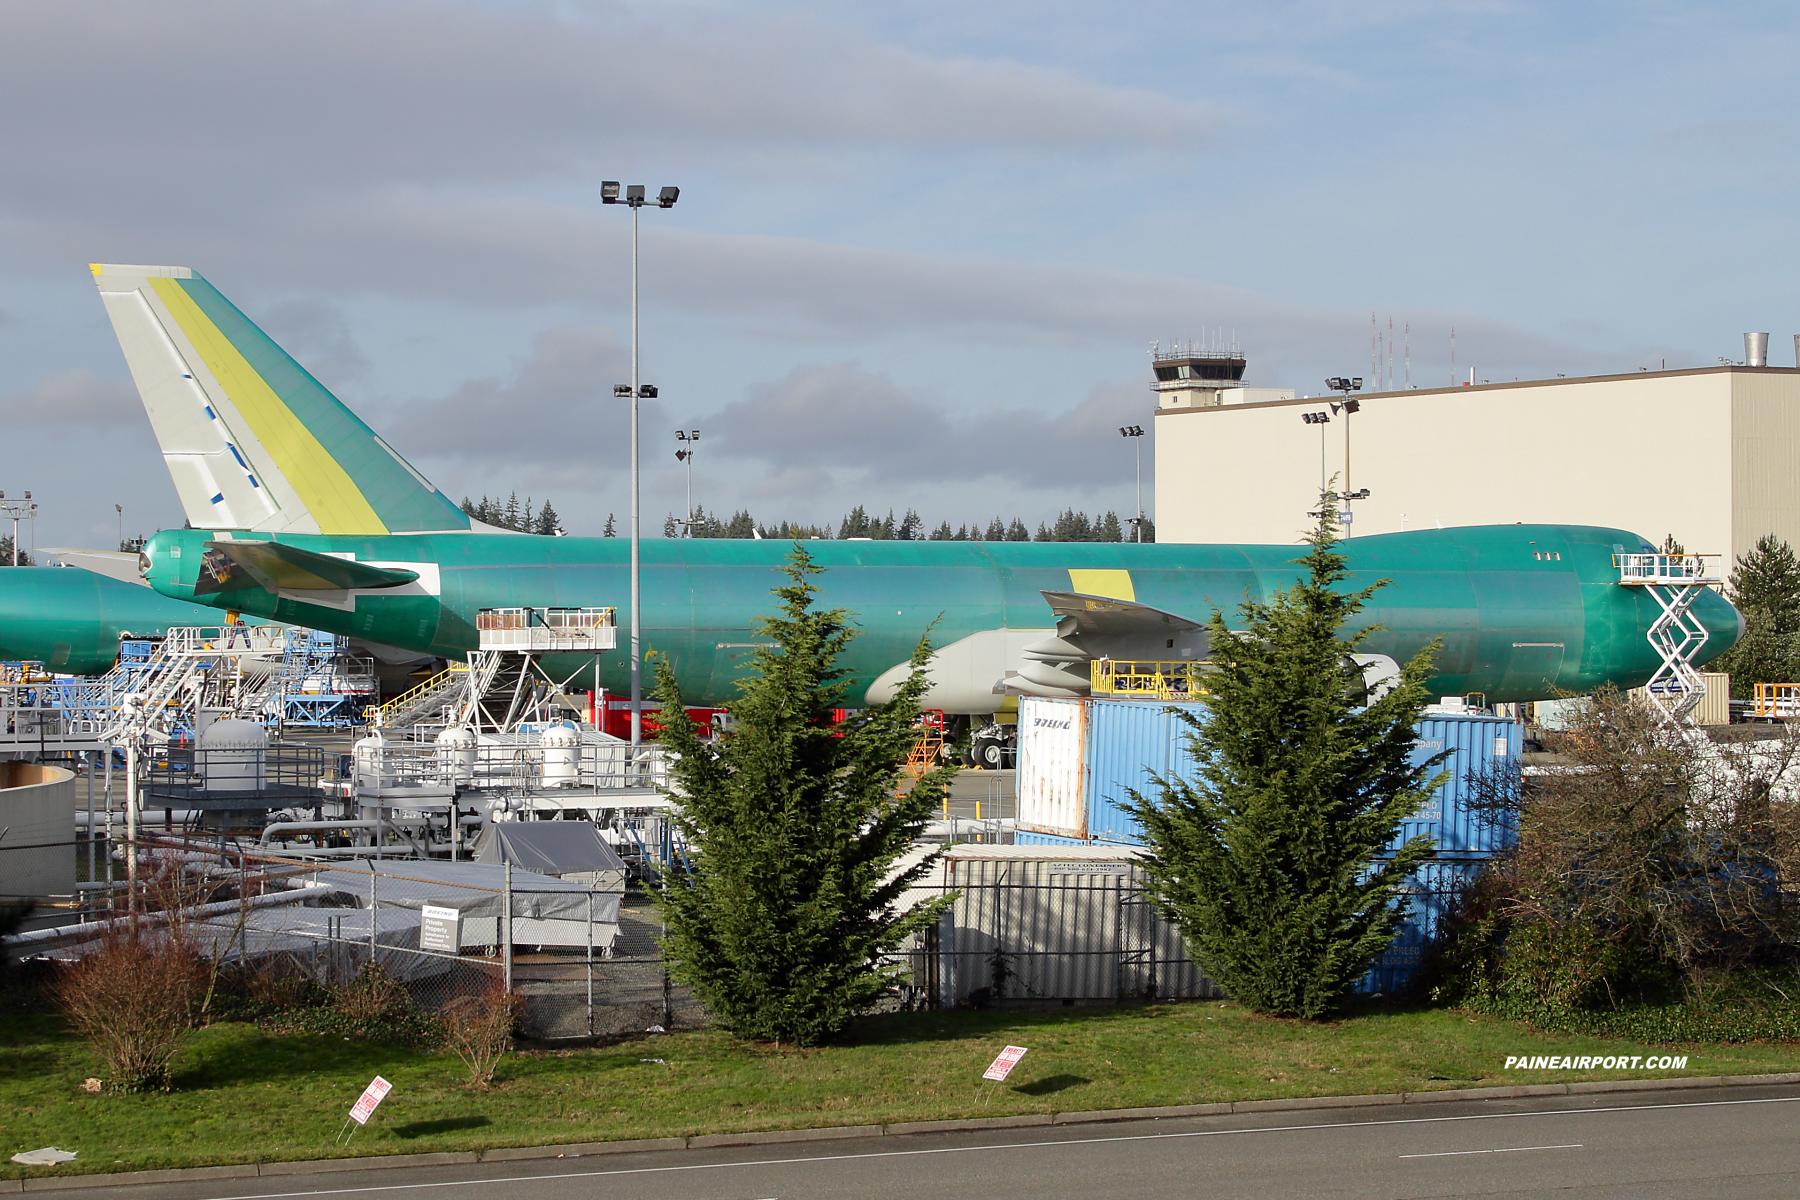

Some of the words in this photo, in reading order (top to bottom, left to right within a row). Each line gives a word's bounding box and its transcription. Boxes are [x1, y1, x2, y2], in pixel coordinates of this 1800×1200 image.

[1421, 811, 1441, 819] 45-70
[427, 909, 454, 917] BOEING
[425, 918, 443, 926] Private
[425, 925, 448, 934] Property
